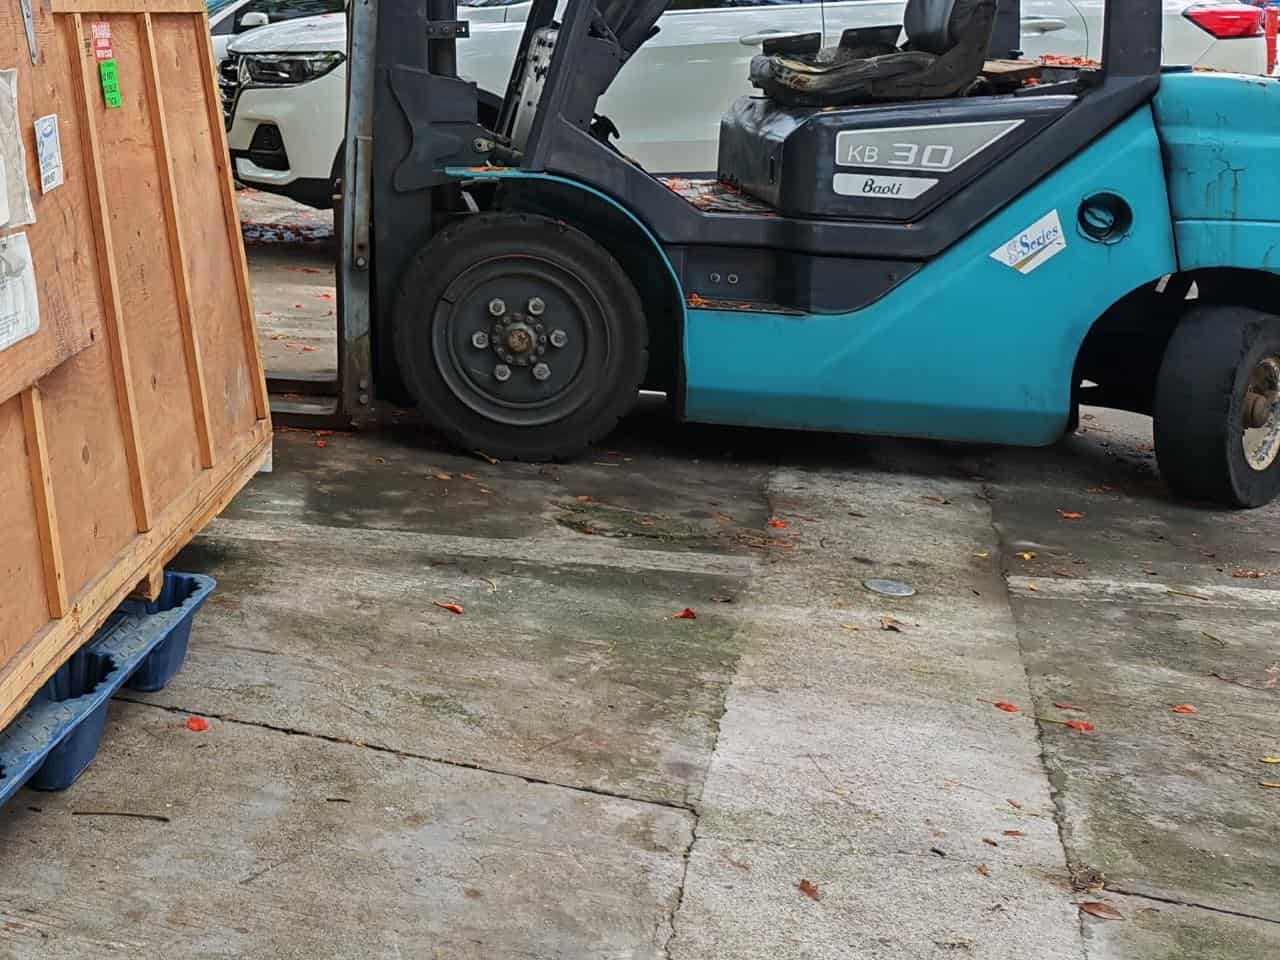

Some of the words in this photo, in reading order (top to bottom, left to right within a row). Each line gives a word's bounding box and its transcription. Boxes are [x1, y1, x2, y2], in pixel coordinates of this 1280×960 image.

[847, 144, 879, 163] KB
[887, 143, 954, 167] 30
[862, 178, 903, 195] Baoli
